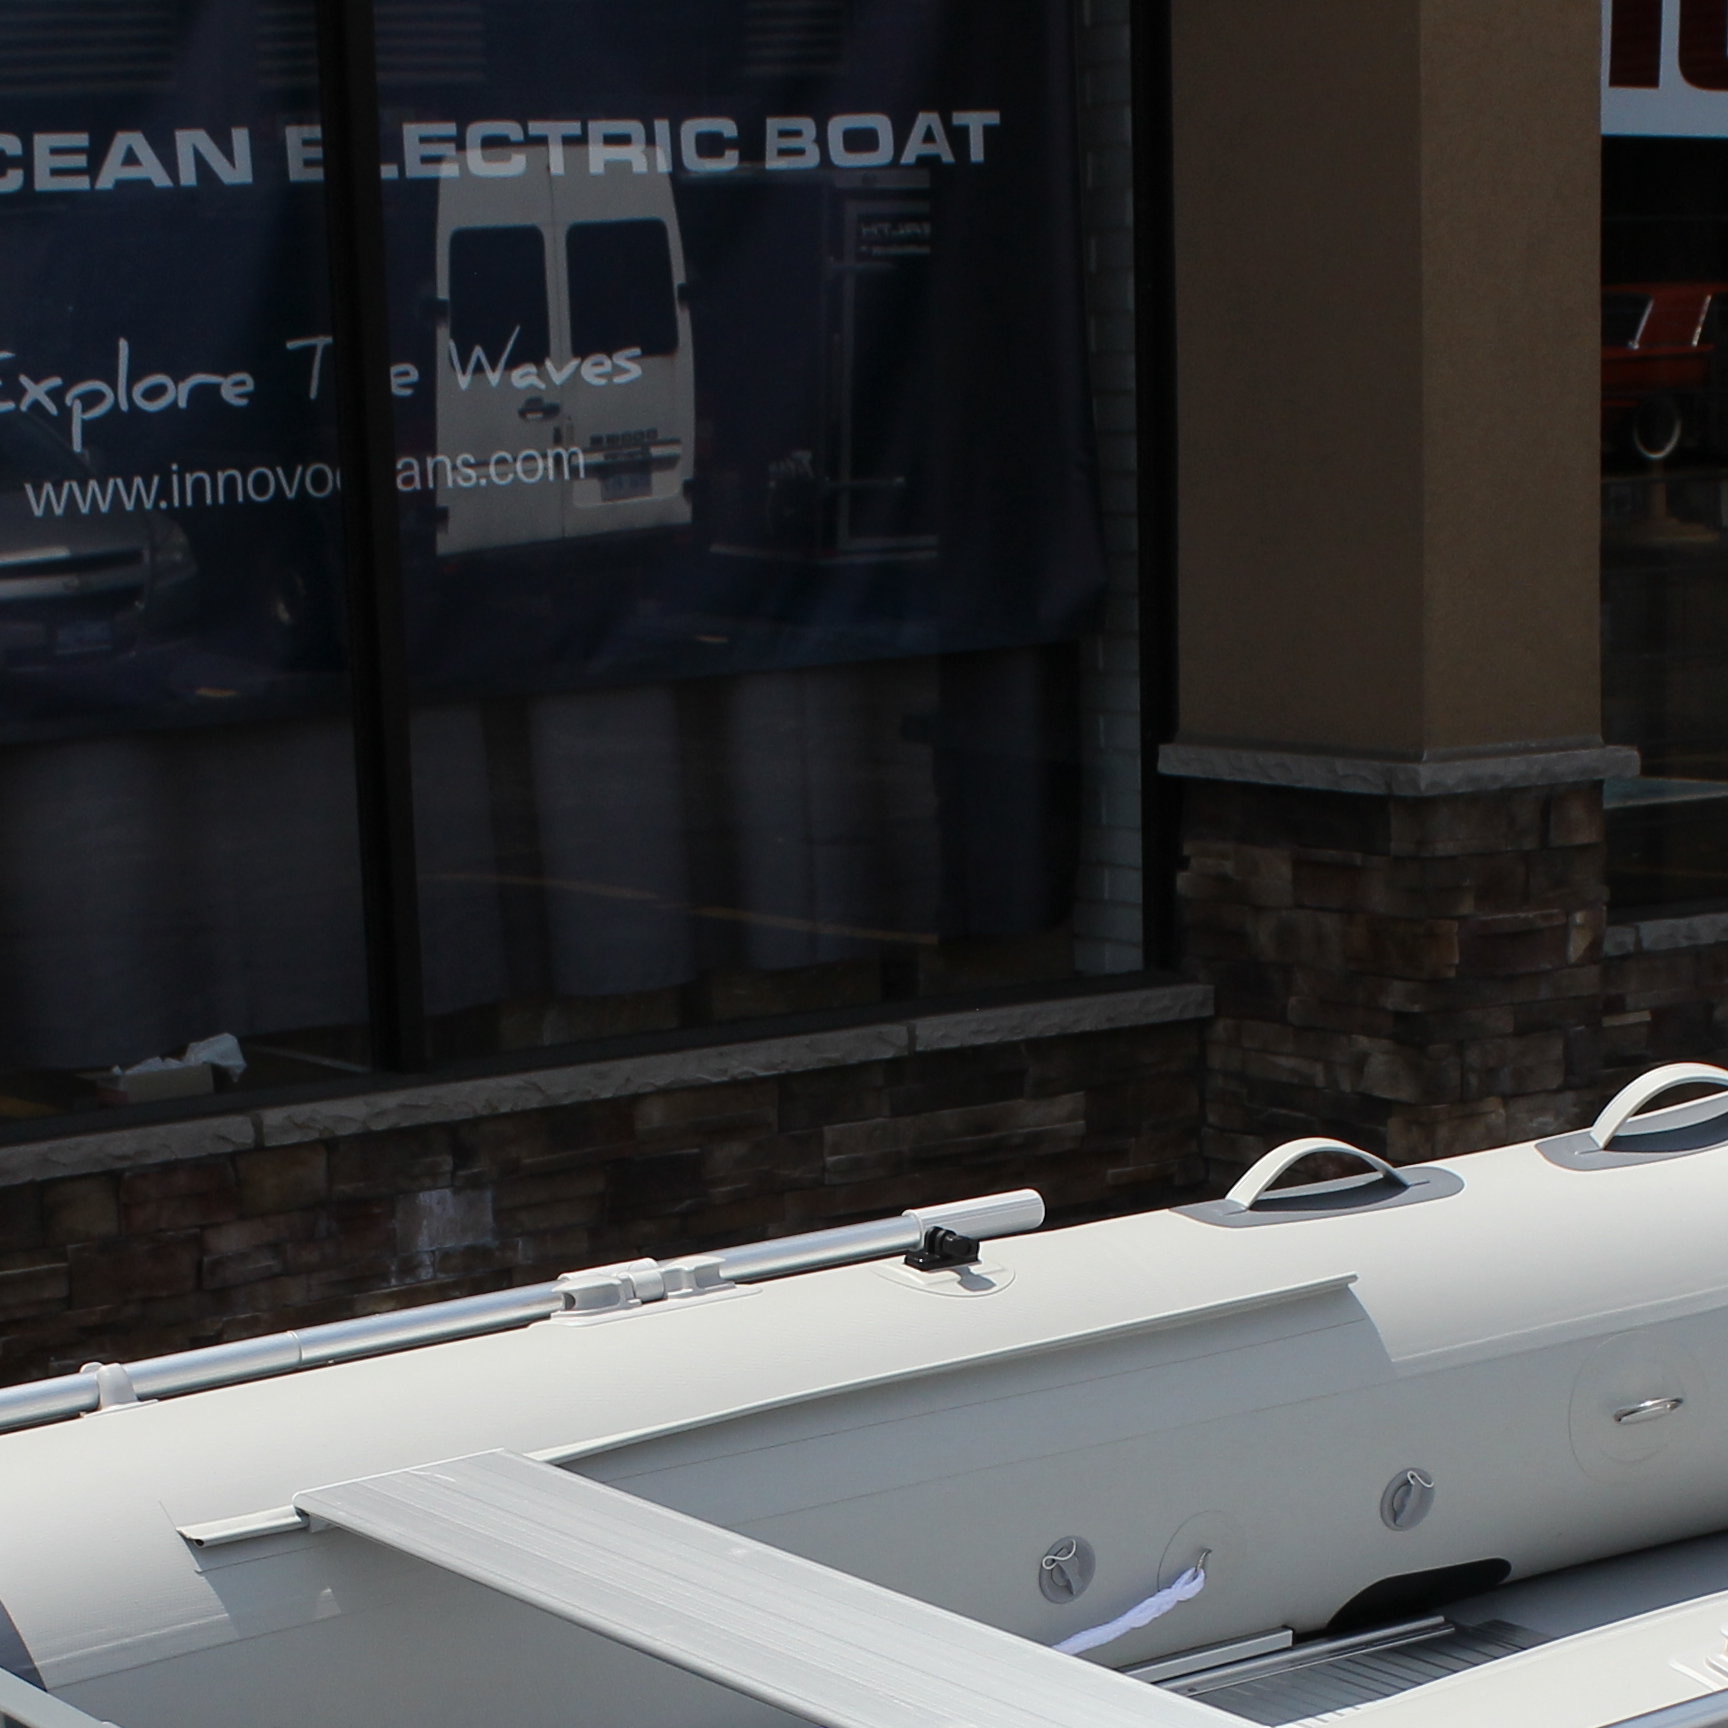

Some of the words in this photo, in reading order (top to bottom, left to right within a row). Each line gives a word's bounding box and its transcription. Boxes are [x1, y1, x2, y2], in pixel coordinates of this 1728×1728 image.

[285, 117, 741, 183] EECTRIC
[764, 110, 1001, 172] BOAT
[285, 335, 420, 400] Te
[449, 326, 643, 391] Waves
[24, 443, 587, 518] www.innovoans.com
